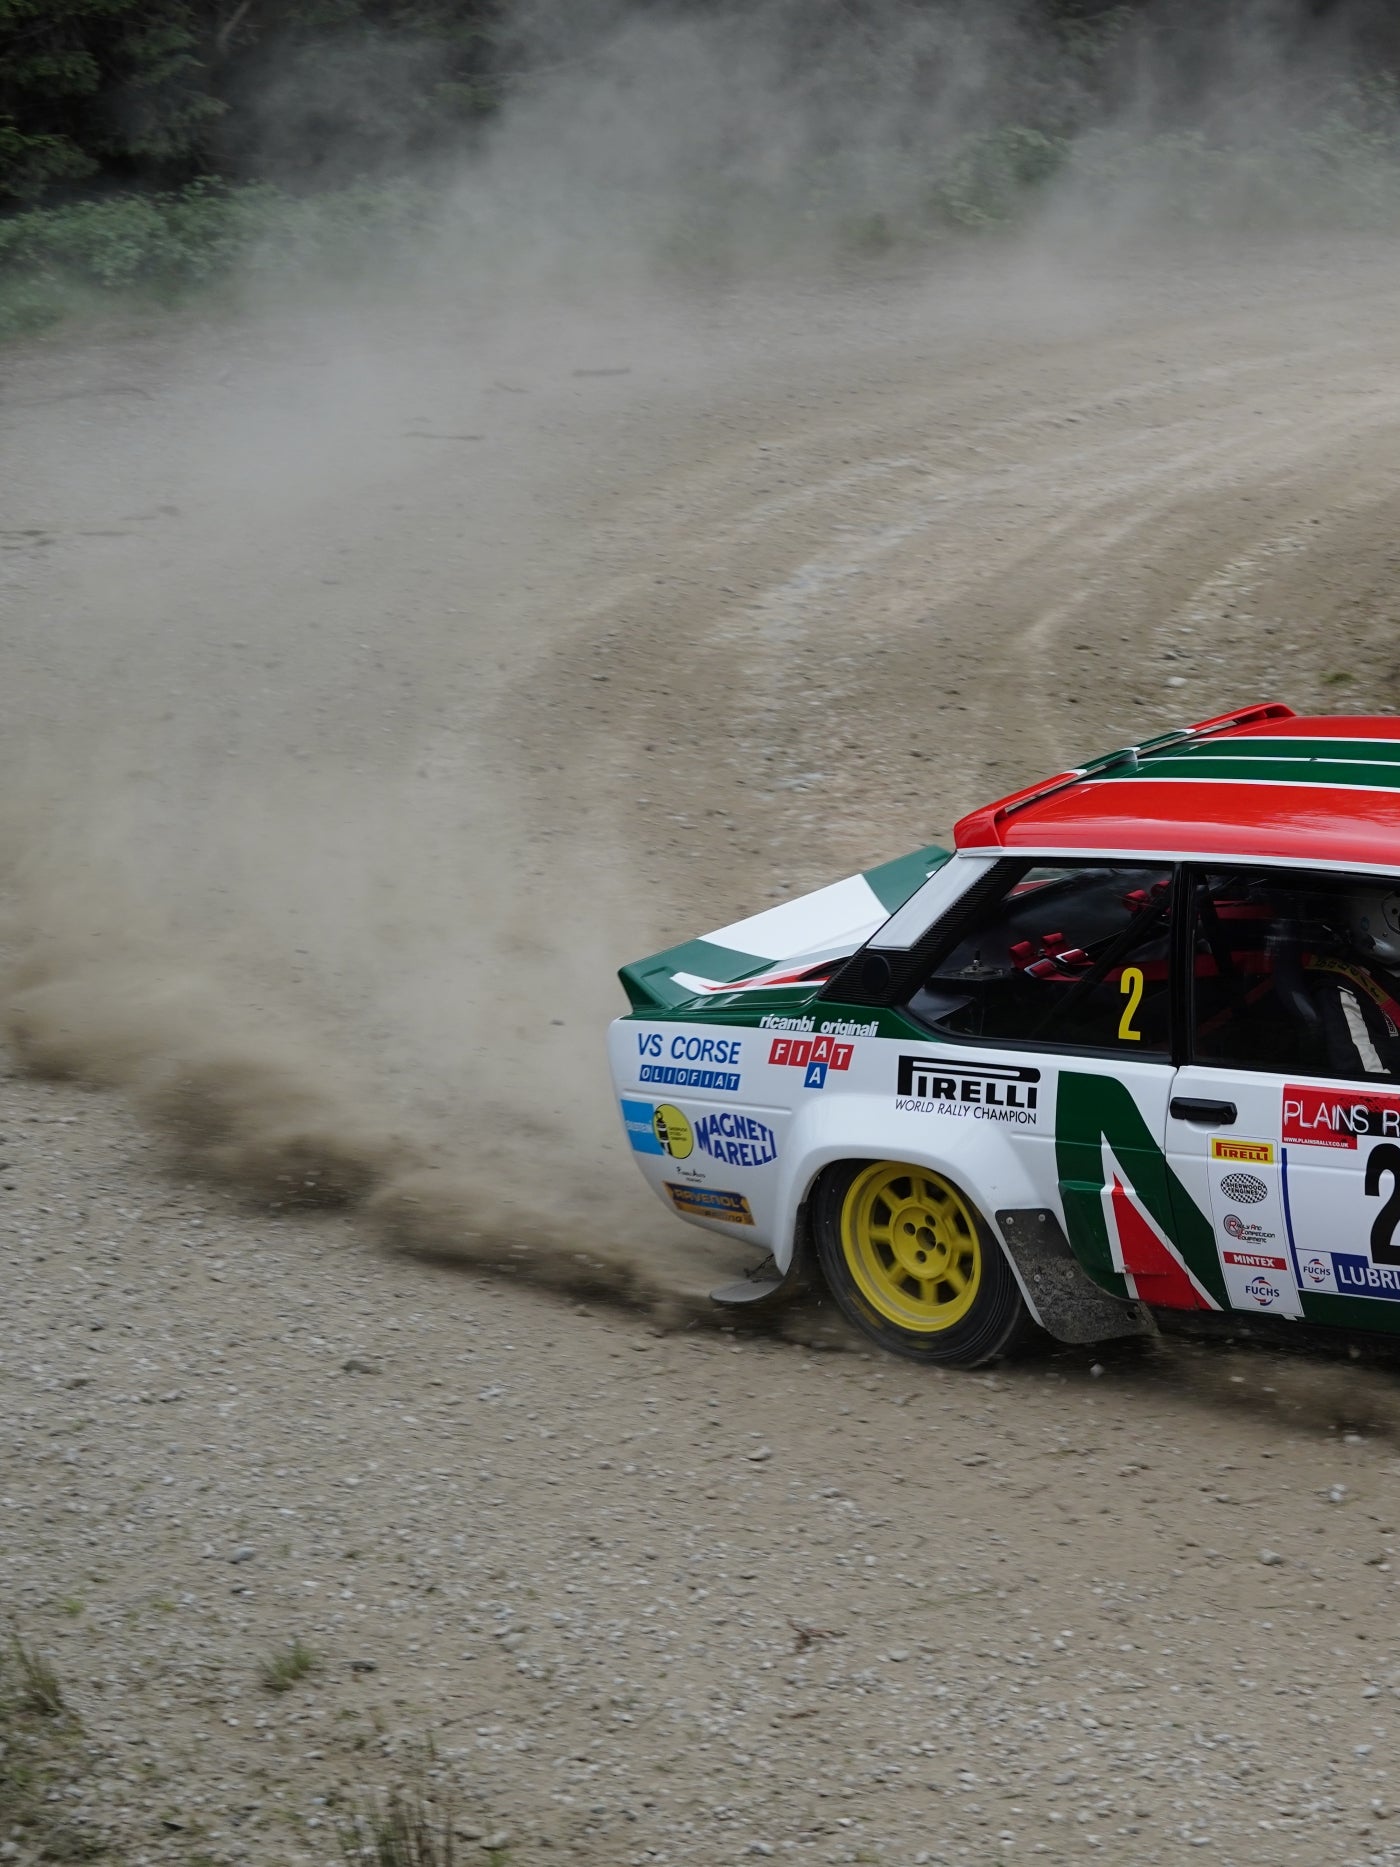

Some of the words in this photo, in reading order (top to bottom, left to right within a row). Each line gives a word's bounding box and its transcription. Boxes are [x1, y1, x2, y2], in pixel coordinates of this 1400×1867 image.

[1117, 967, 1143, 1041] 2
[759, 1014, 815, 1033] ricambi
[820, 1020, 880, 1038] originali
[638, 1032, 662, 1058] VS
[671, 1036, 741, 1065] CORSE
[770, 1038, 852, 1069] FIAT
[897, 1055, 1041, 1109] PIRELLI
[895, 1099, 934, 1113] WORLD
[937, 1103, 970, 1117] RALLY
[973, 1106, 1037, 1125] CHAMPION
[1283, 1100, 1369, 1133] PLAINS
[695, 1113, 776, 1149] MAGNETI
[1283, 1136, 1349, 1148] WWW.PLAINSRALLY.CO.UK
[697, 1132, 778, 1167] MARELLI
[1216, 1142, 1269, 1162] PIRELLI
[1234, 1254, 1275, 1268] MINTEX
[1303, 1265, 1331, 1277] FUCHS
[1245, 1285, 1280, 1298] FUCHS
